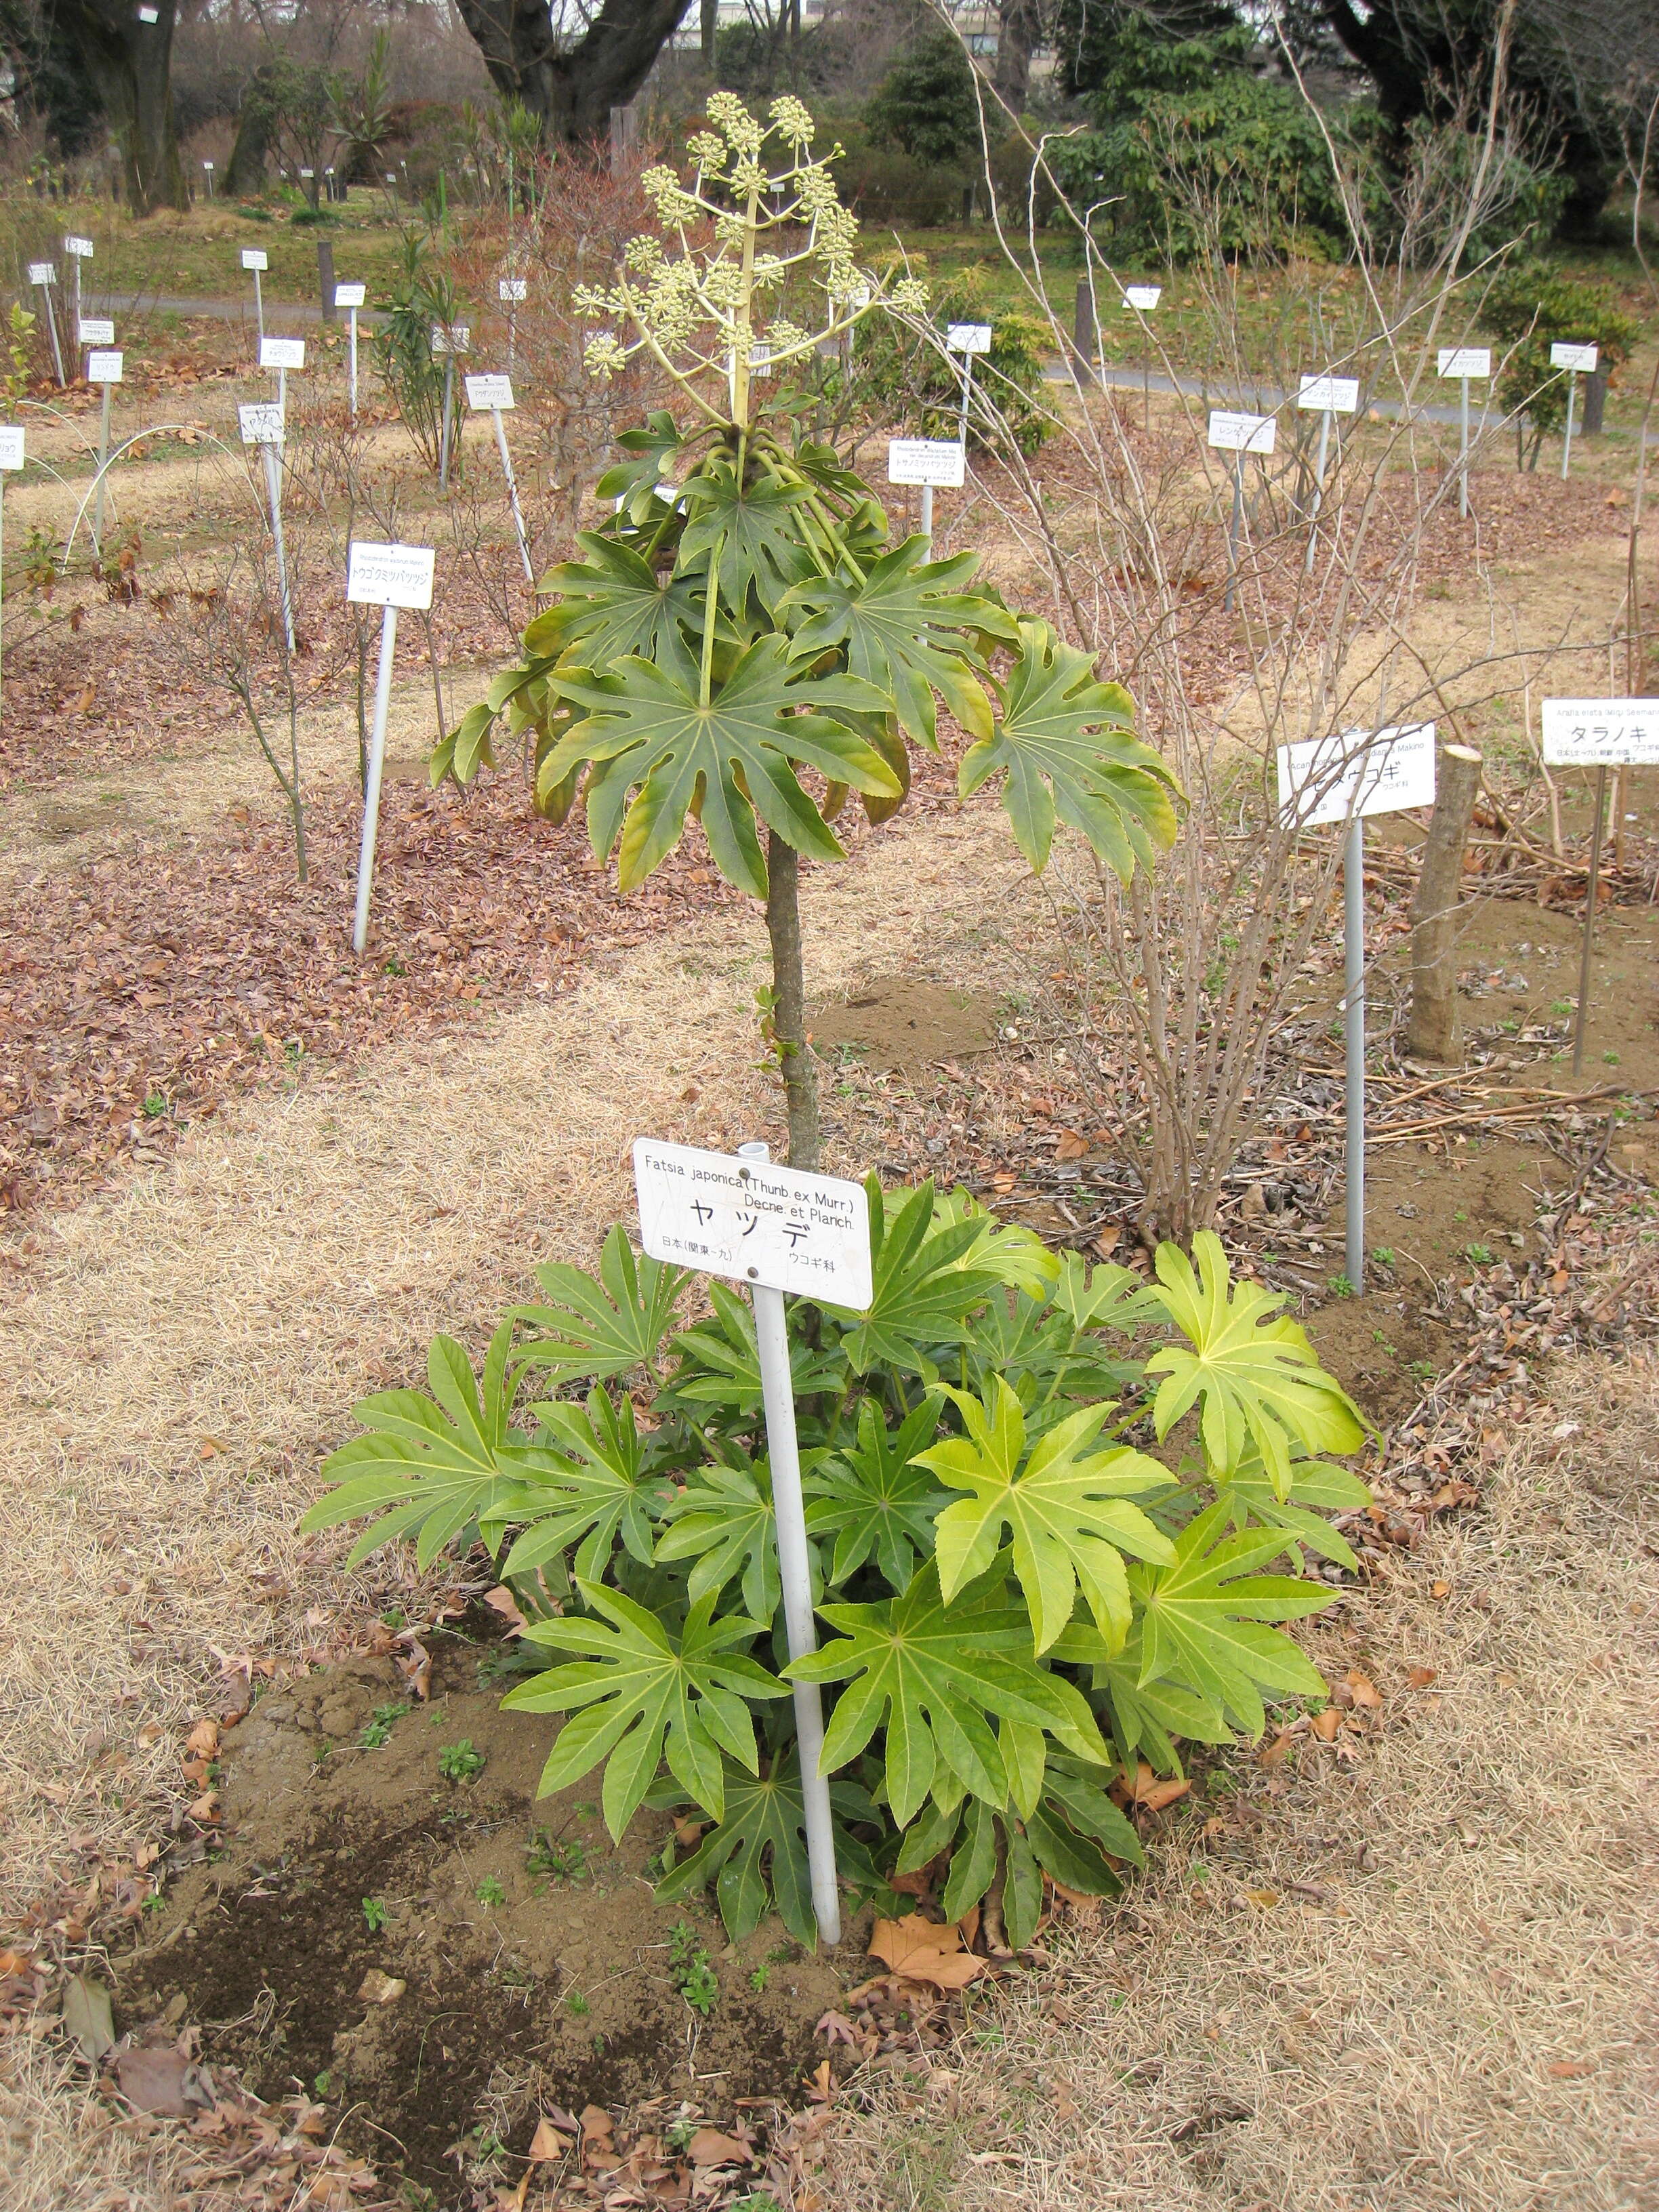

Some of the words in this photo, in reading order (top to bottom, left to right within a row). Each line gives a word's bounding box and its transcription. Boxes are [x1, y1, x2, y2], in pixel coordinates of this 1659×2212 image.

[1572, 725, 1647, 743] タラノキ
[1397, 743, 1425, 753] Makino
[645, 1155, 686, 1176] Fatsia
[795, 1191, 809, 1202] ex
[815, 1192, 854, 1214] Murr.)
[744, 1193, 786, 1214] Decne.
[790, 1206, 804, 1218] et
[690, 1198, 811, 1248] ヤツデ
[789, 1252, 836, 1273] ウコギ科
